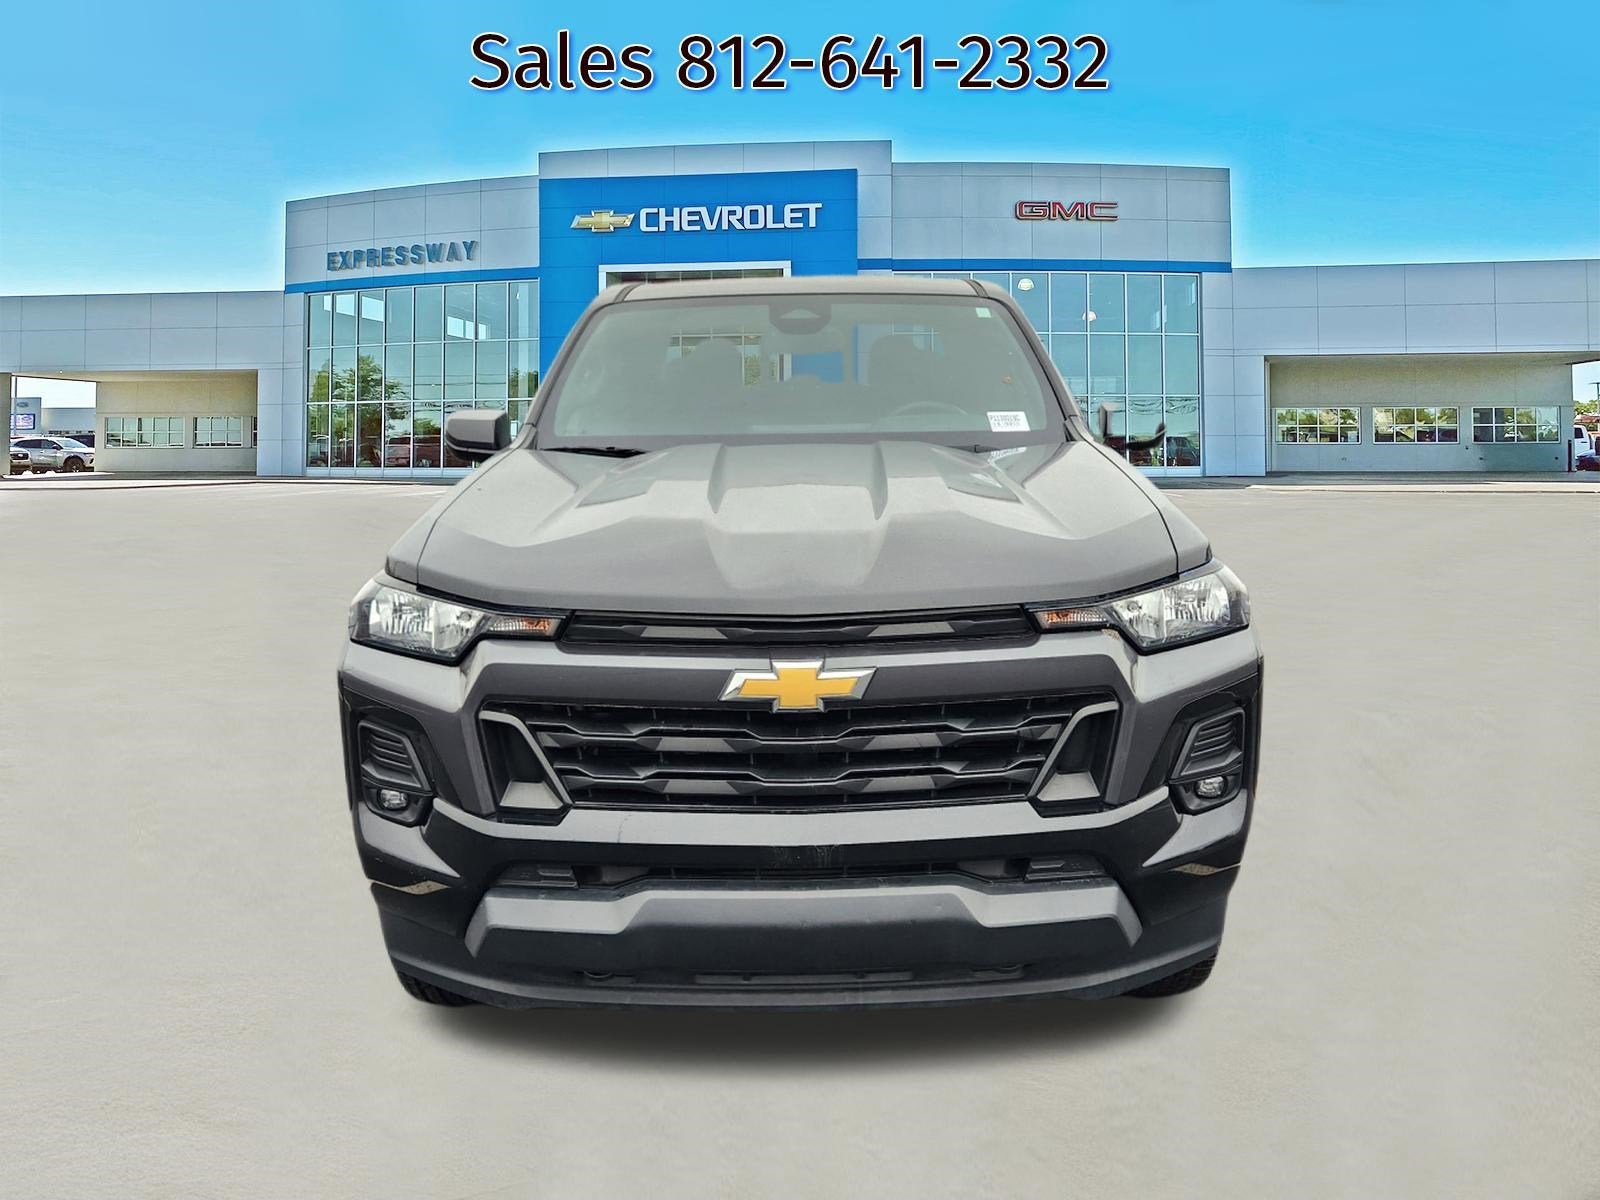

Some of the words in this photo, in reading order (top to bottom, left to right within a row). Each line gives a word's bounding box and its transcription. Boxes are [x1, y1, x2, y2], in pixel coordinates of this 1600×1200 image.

[640, 203, 823, 232] CHEVROLET
[1015, 200, 1119, 221] GMC
[327, 240, 478, 271] EXPRESSWAY
